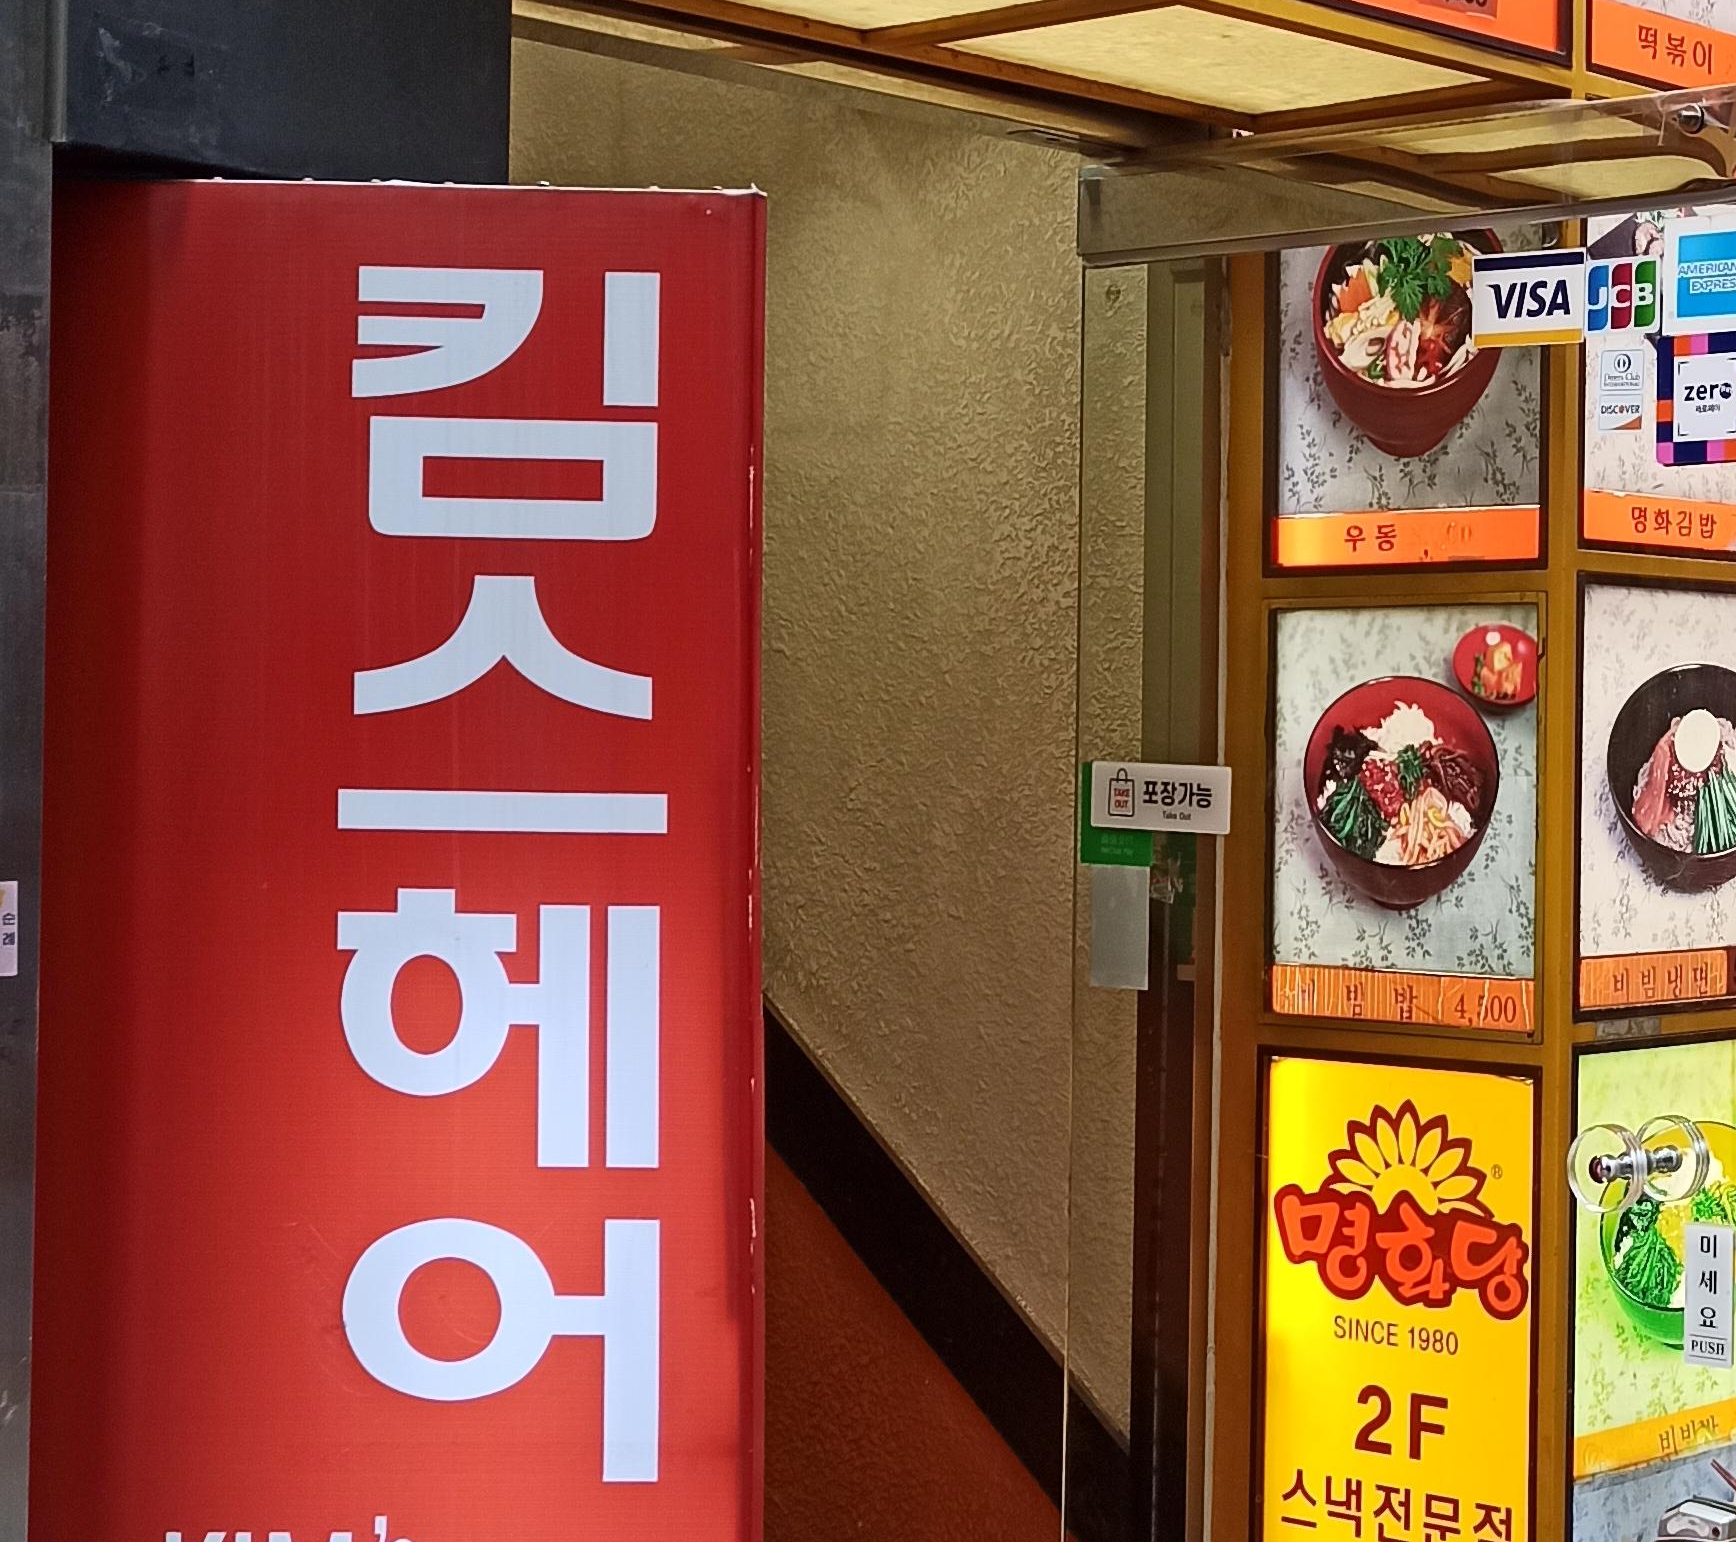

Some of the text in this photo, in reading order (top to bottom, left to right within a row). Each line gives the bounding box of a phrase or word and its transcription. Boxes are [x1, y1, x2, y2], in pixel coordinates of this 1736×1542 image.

[1637, 24, 1714, 75] 떡볶이
[1488, 279, 1571, 319] VISA
[1588, 283, 1654, 310] JCB
[1600, 404, 1641, 415] DISCOVER
[1344, 523, 1397, 552] 우동
[1631, 505, 1718, 540] 명화김밥
[1114, 788, 1131, 797] TAKE
[1114, 799, 1129, 809] OUT
[1143, 780, 1213, 809] 포장가능
[1162, 811, 1192, 821] Take Out
[338, 265, 669, 1482] 킴스헤어
[1454, 994, 1517, 1027] 4,500
[1282, 1194, 1522, 1312] 명화당
[1698, 1234, 1718, 1329] 미세요
[1333, 1315, 1459, 1356] SINCE 1980
[1355, 1384, 1448, 1460] 2F
